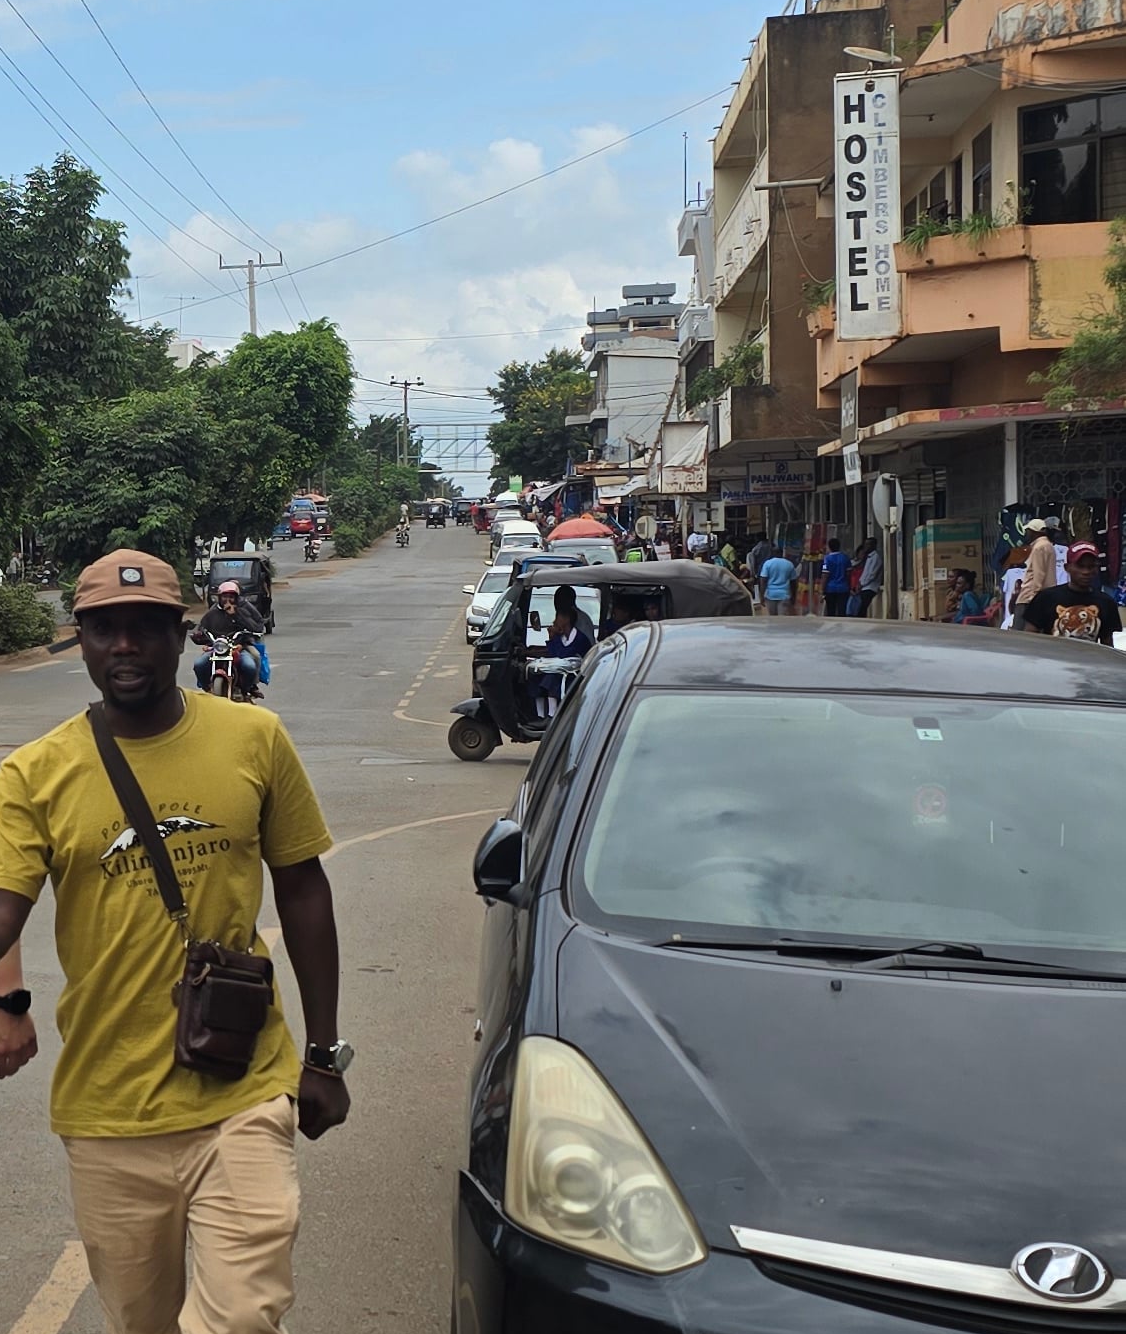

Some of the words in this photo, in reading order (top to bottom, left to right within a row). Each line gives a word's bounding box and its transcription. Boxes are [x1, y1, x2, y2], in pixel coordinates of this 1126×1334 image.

[872, 93, 889, 235] CLIMBERS
[843, 93, 869, 312] HOSTEL
[874, 244, 891, 312] HOME
[158, 801, 203, 814] POLE
[100, 837, 231, 880] Kilimnjaro
[146, 880, 195, 897] TANIA
